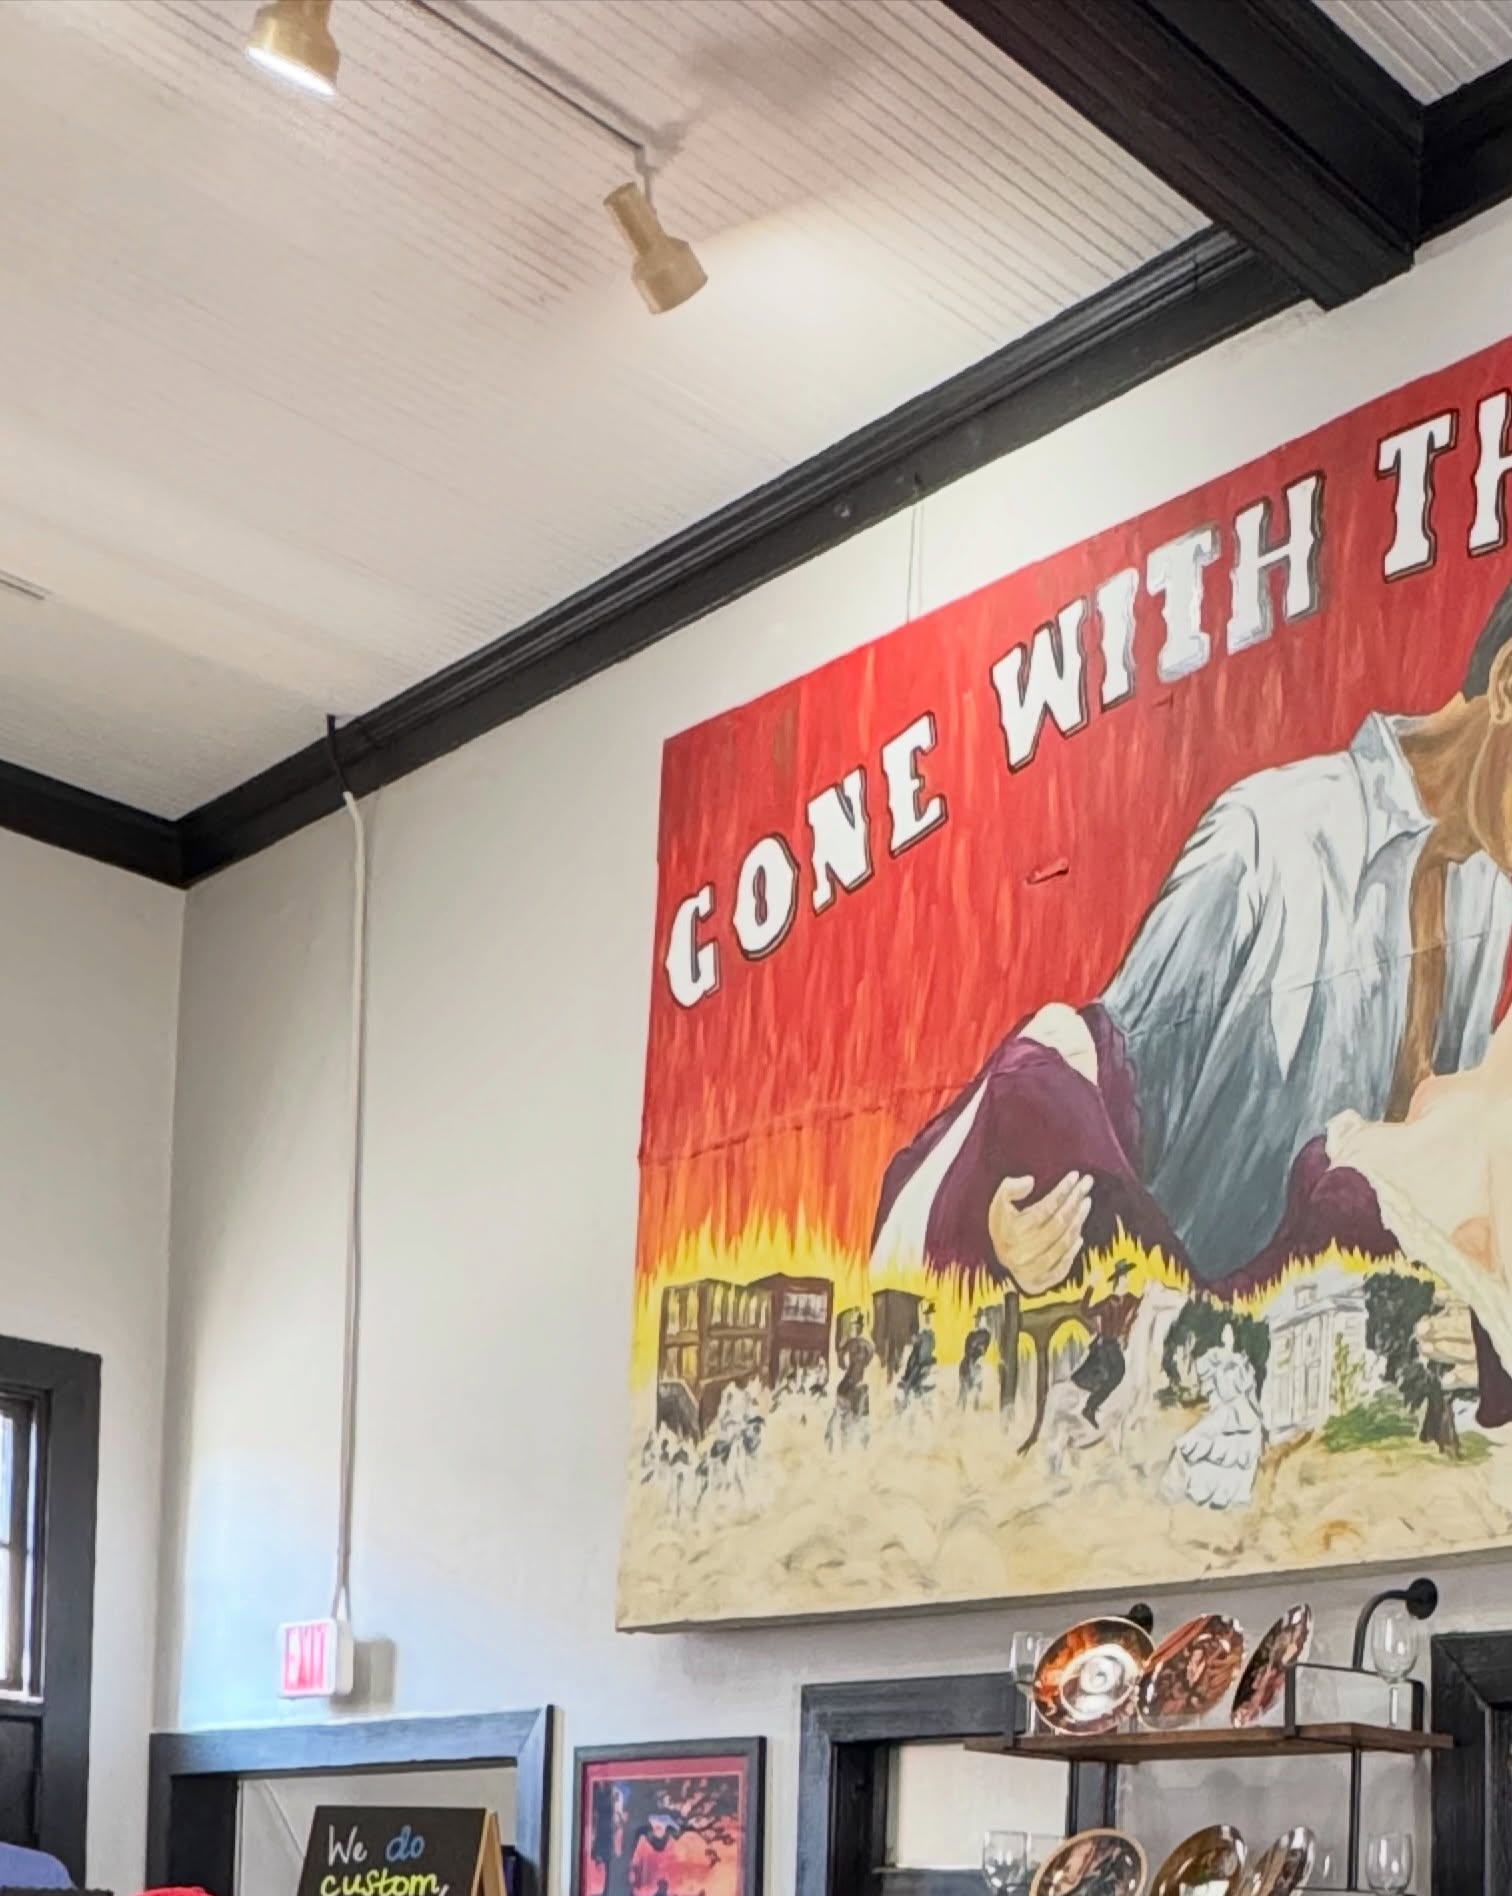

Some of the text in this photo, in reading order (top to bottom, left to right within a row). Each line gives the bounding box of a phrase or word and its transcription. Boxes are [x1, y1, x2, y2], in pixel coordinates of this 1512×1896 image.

[664, 710, 947, 1009] GONE
[990, 471, 1325, 774] WITH
[328, 1824, 425, 1866] We do
